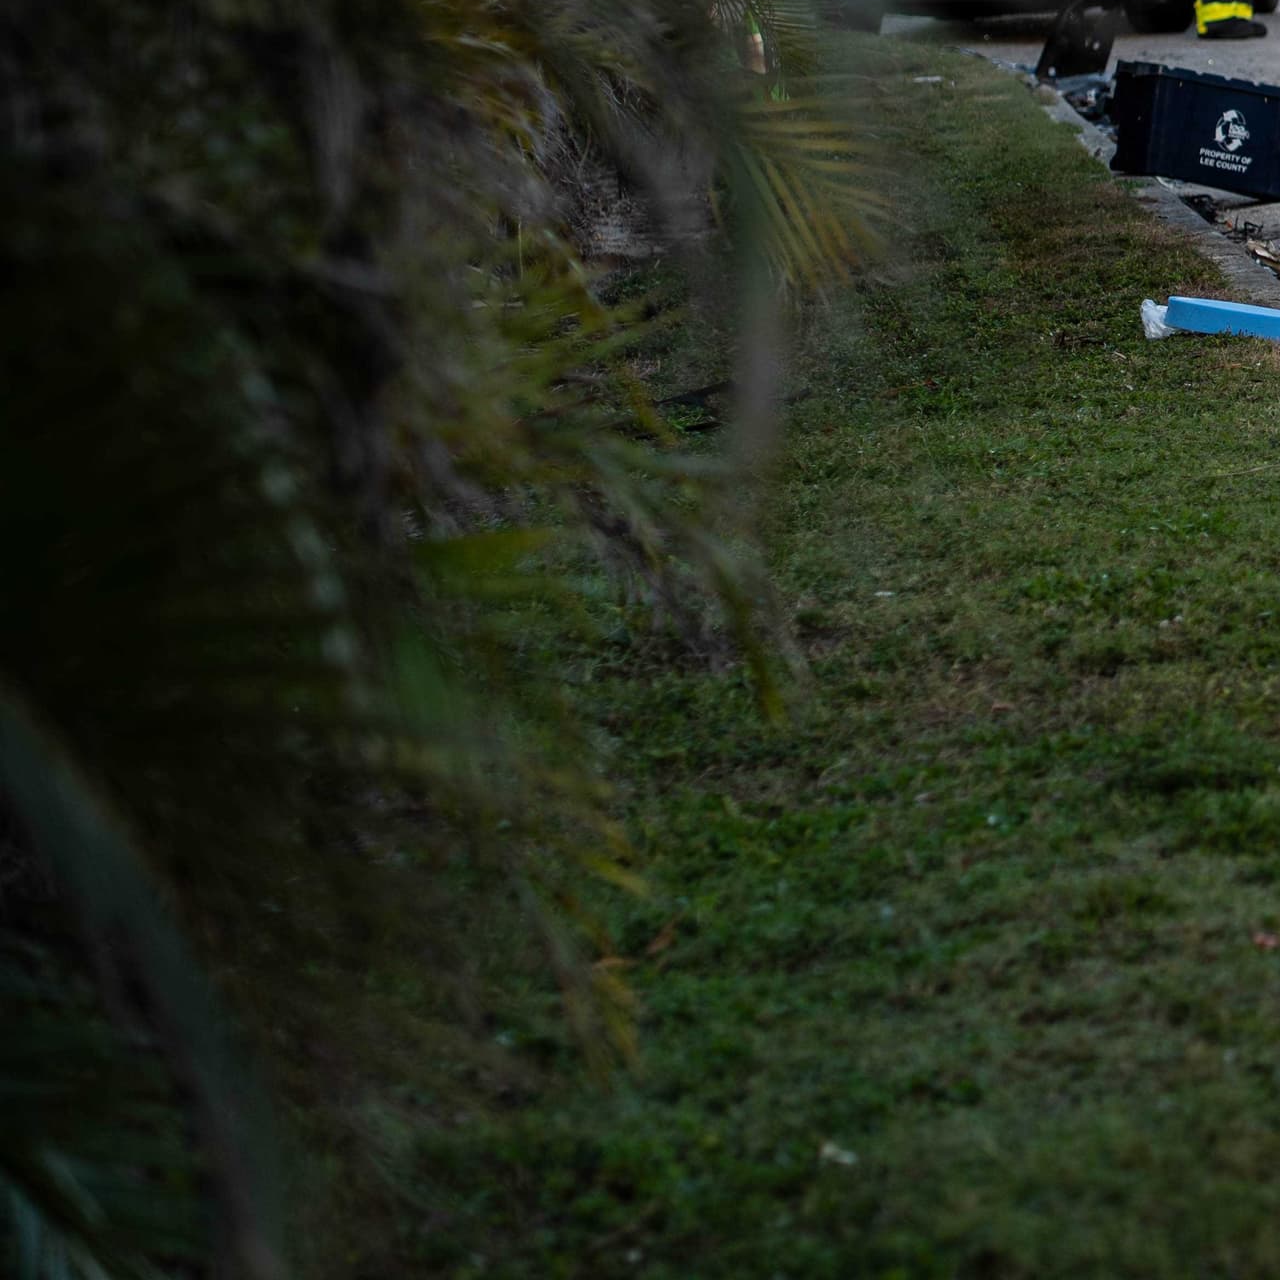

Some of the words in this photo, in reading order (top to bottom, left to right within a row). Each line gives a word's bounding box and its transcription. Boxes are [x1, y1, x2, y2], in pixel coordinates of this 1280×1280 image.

[1200, 148, 1241, 163] PROPERTY
[1241, 156, 1252, 165] OF
[1200, 156, 1216, 167] LEE
[1216, 160, 1248, 173] COUNTY
